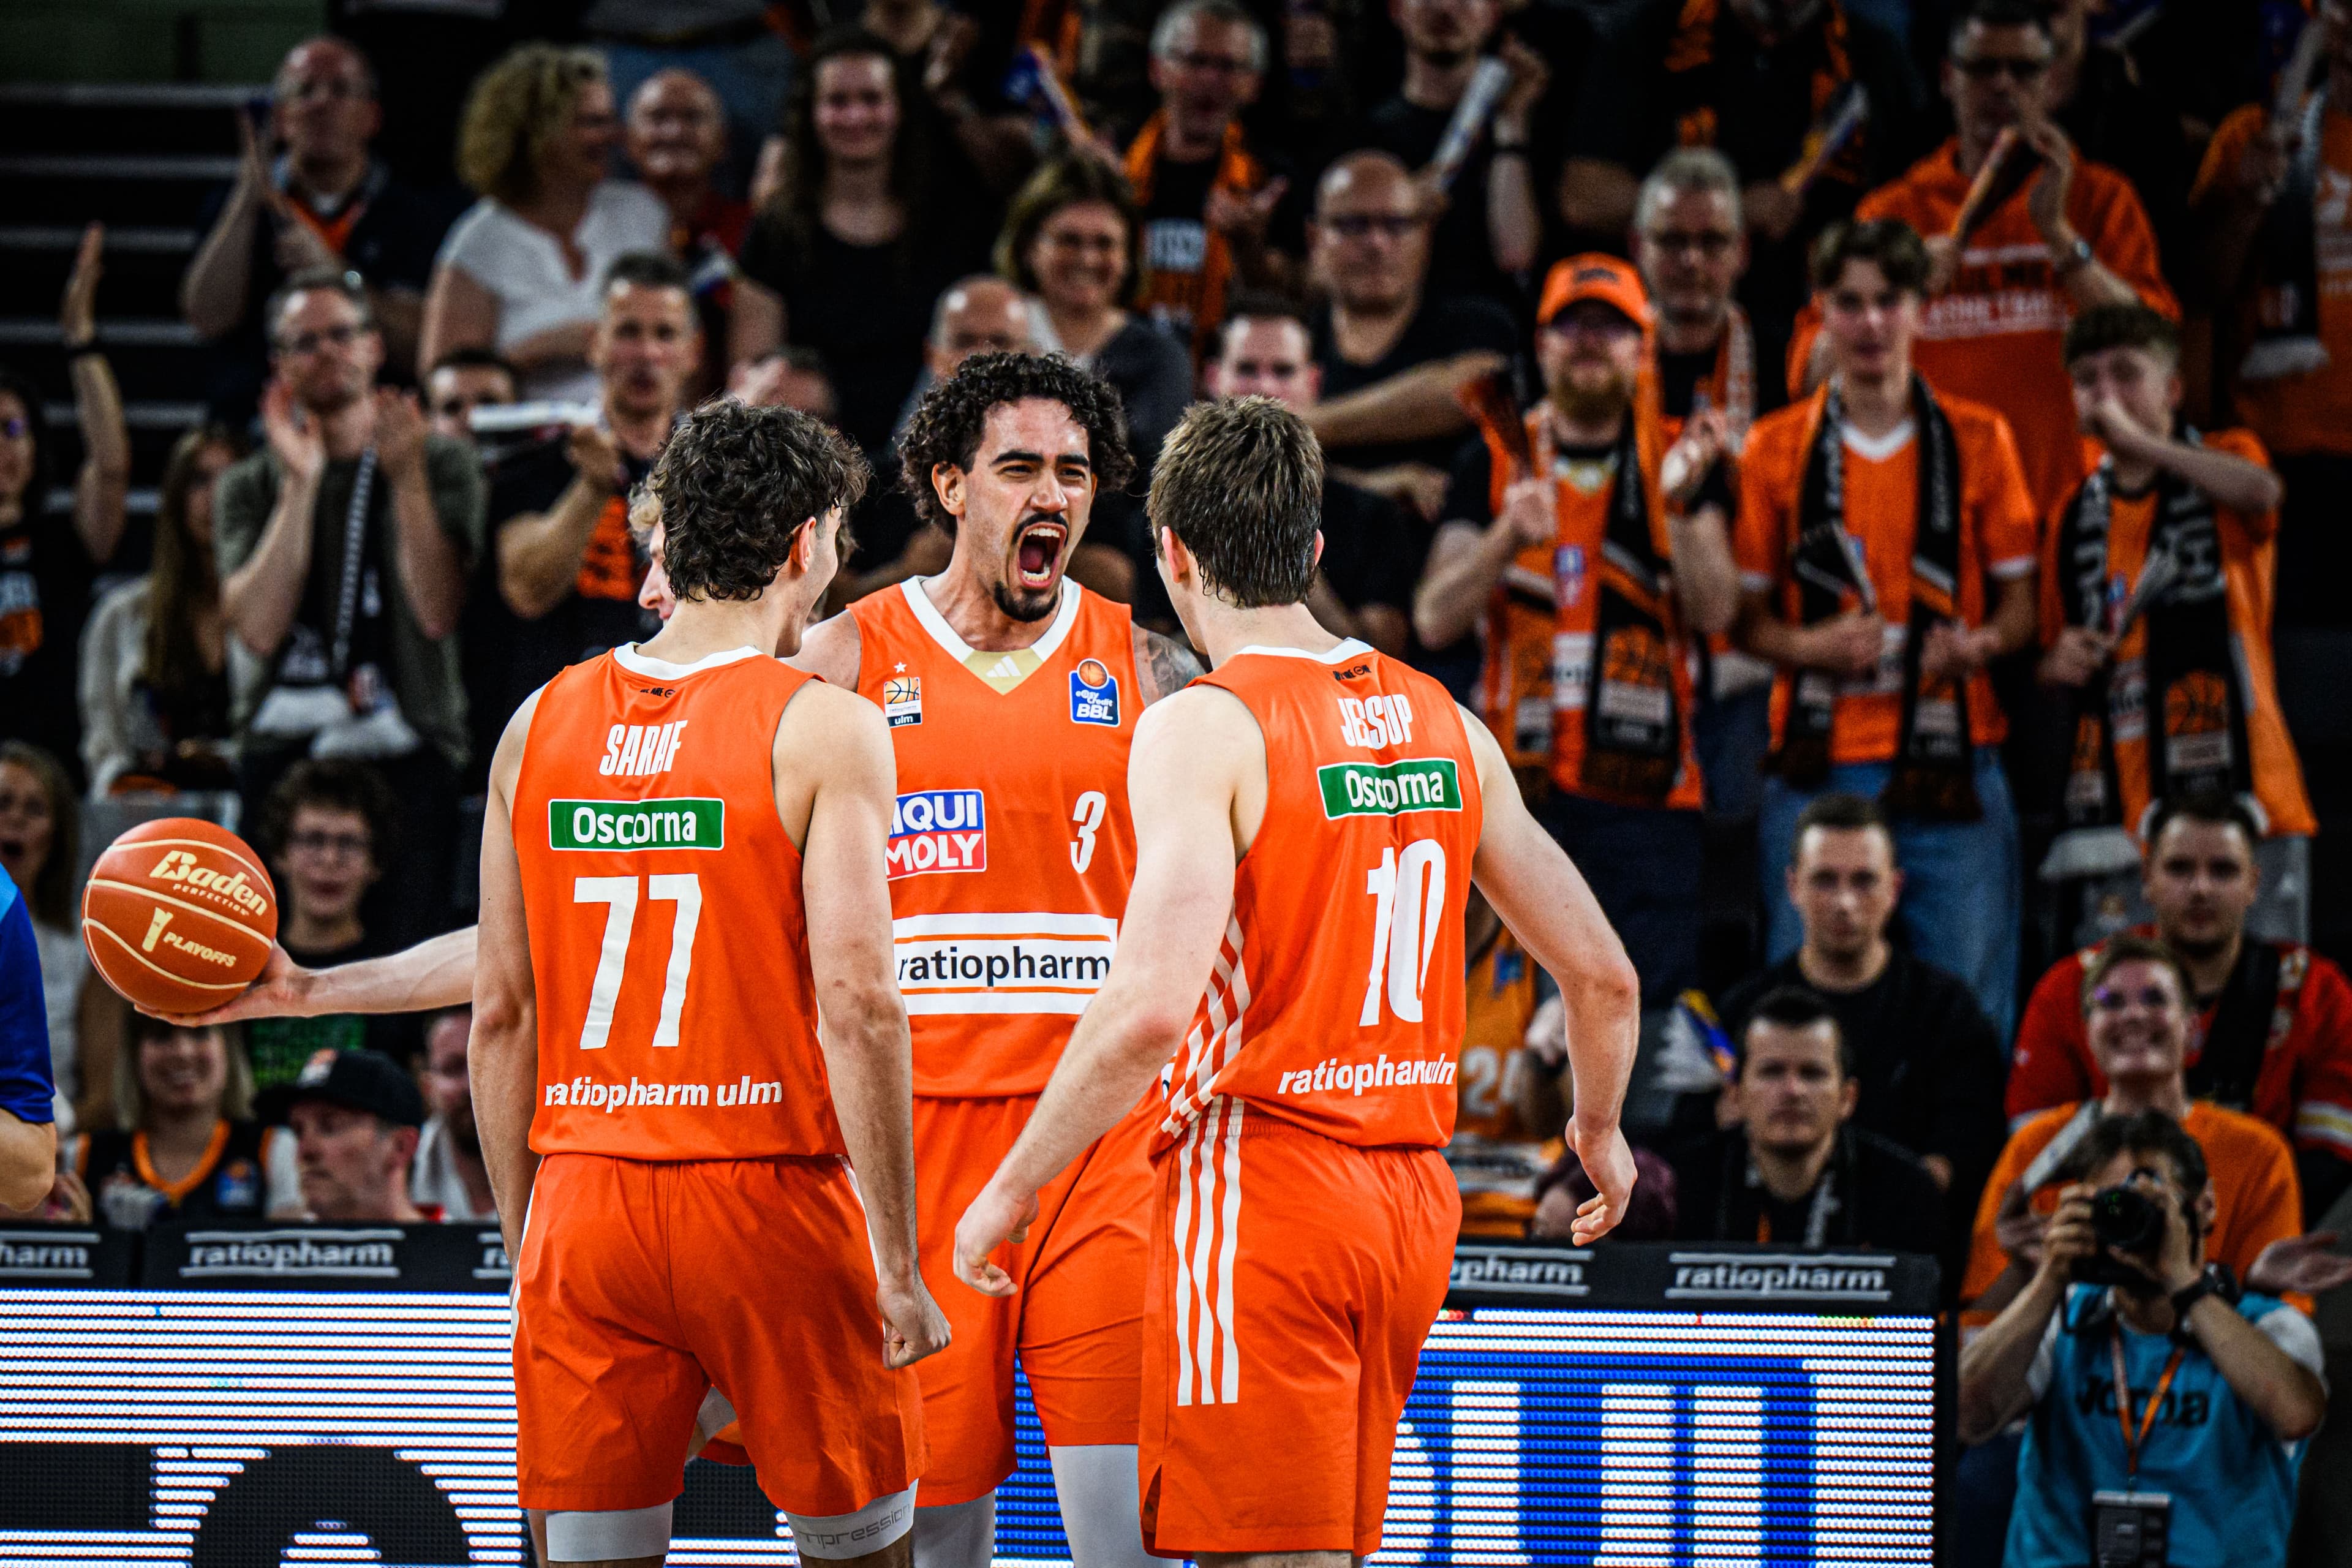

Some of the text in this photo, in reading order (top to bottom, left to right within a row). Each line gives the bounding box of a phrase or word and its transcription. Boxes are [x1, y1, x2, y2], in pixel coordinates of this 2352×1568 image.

[894, 715, 913, 725] ulm
[1076, 703, 1114, 720] BBL
[1337, 694, 1412, 750] JESUP
[599, 720, 688, 776] SARAF
[1345, 769, 1444, 810] Oscorna
[573, 807, 696, 845] Oscorna
[889, 794, 978, 835] IQUI
[1071, 791, 1106, 874] 3
[884, 834, 982, 875] MOLY
[149, 850, 267, 916] Baden
[163, 931, 236, 967] PLAYOFFS
[1359, 839, 1446, 1027] 10
[573, 874, 703, 1050] 77
[898, 946, 1110, 987] ratiopharm
[545, 1076, 782, 1113] ratiopharm ulm
[189, 1238, 393, 1272] ratiopharm
[1676, 1262, 1885, 1295] ratiopharm
[798, 1503, 911, 1549] mpression
